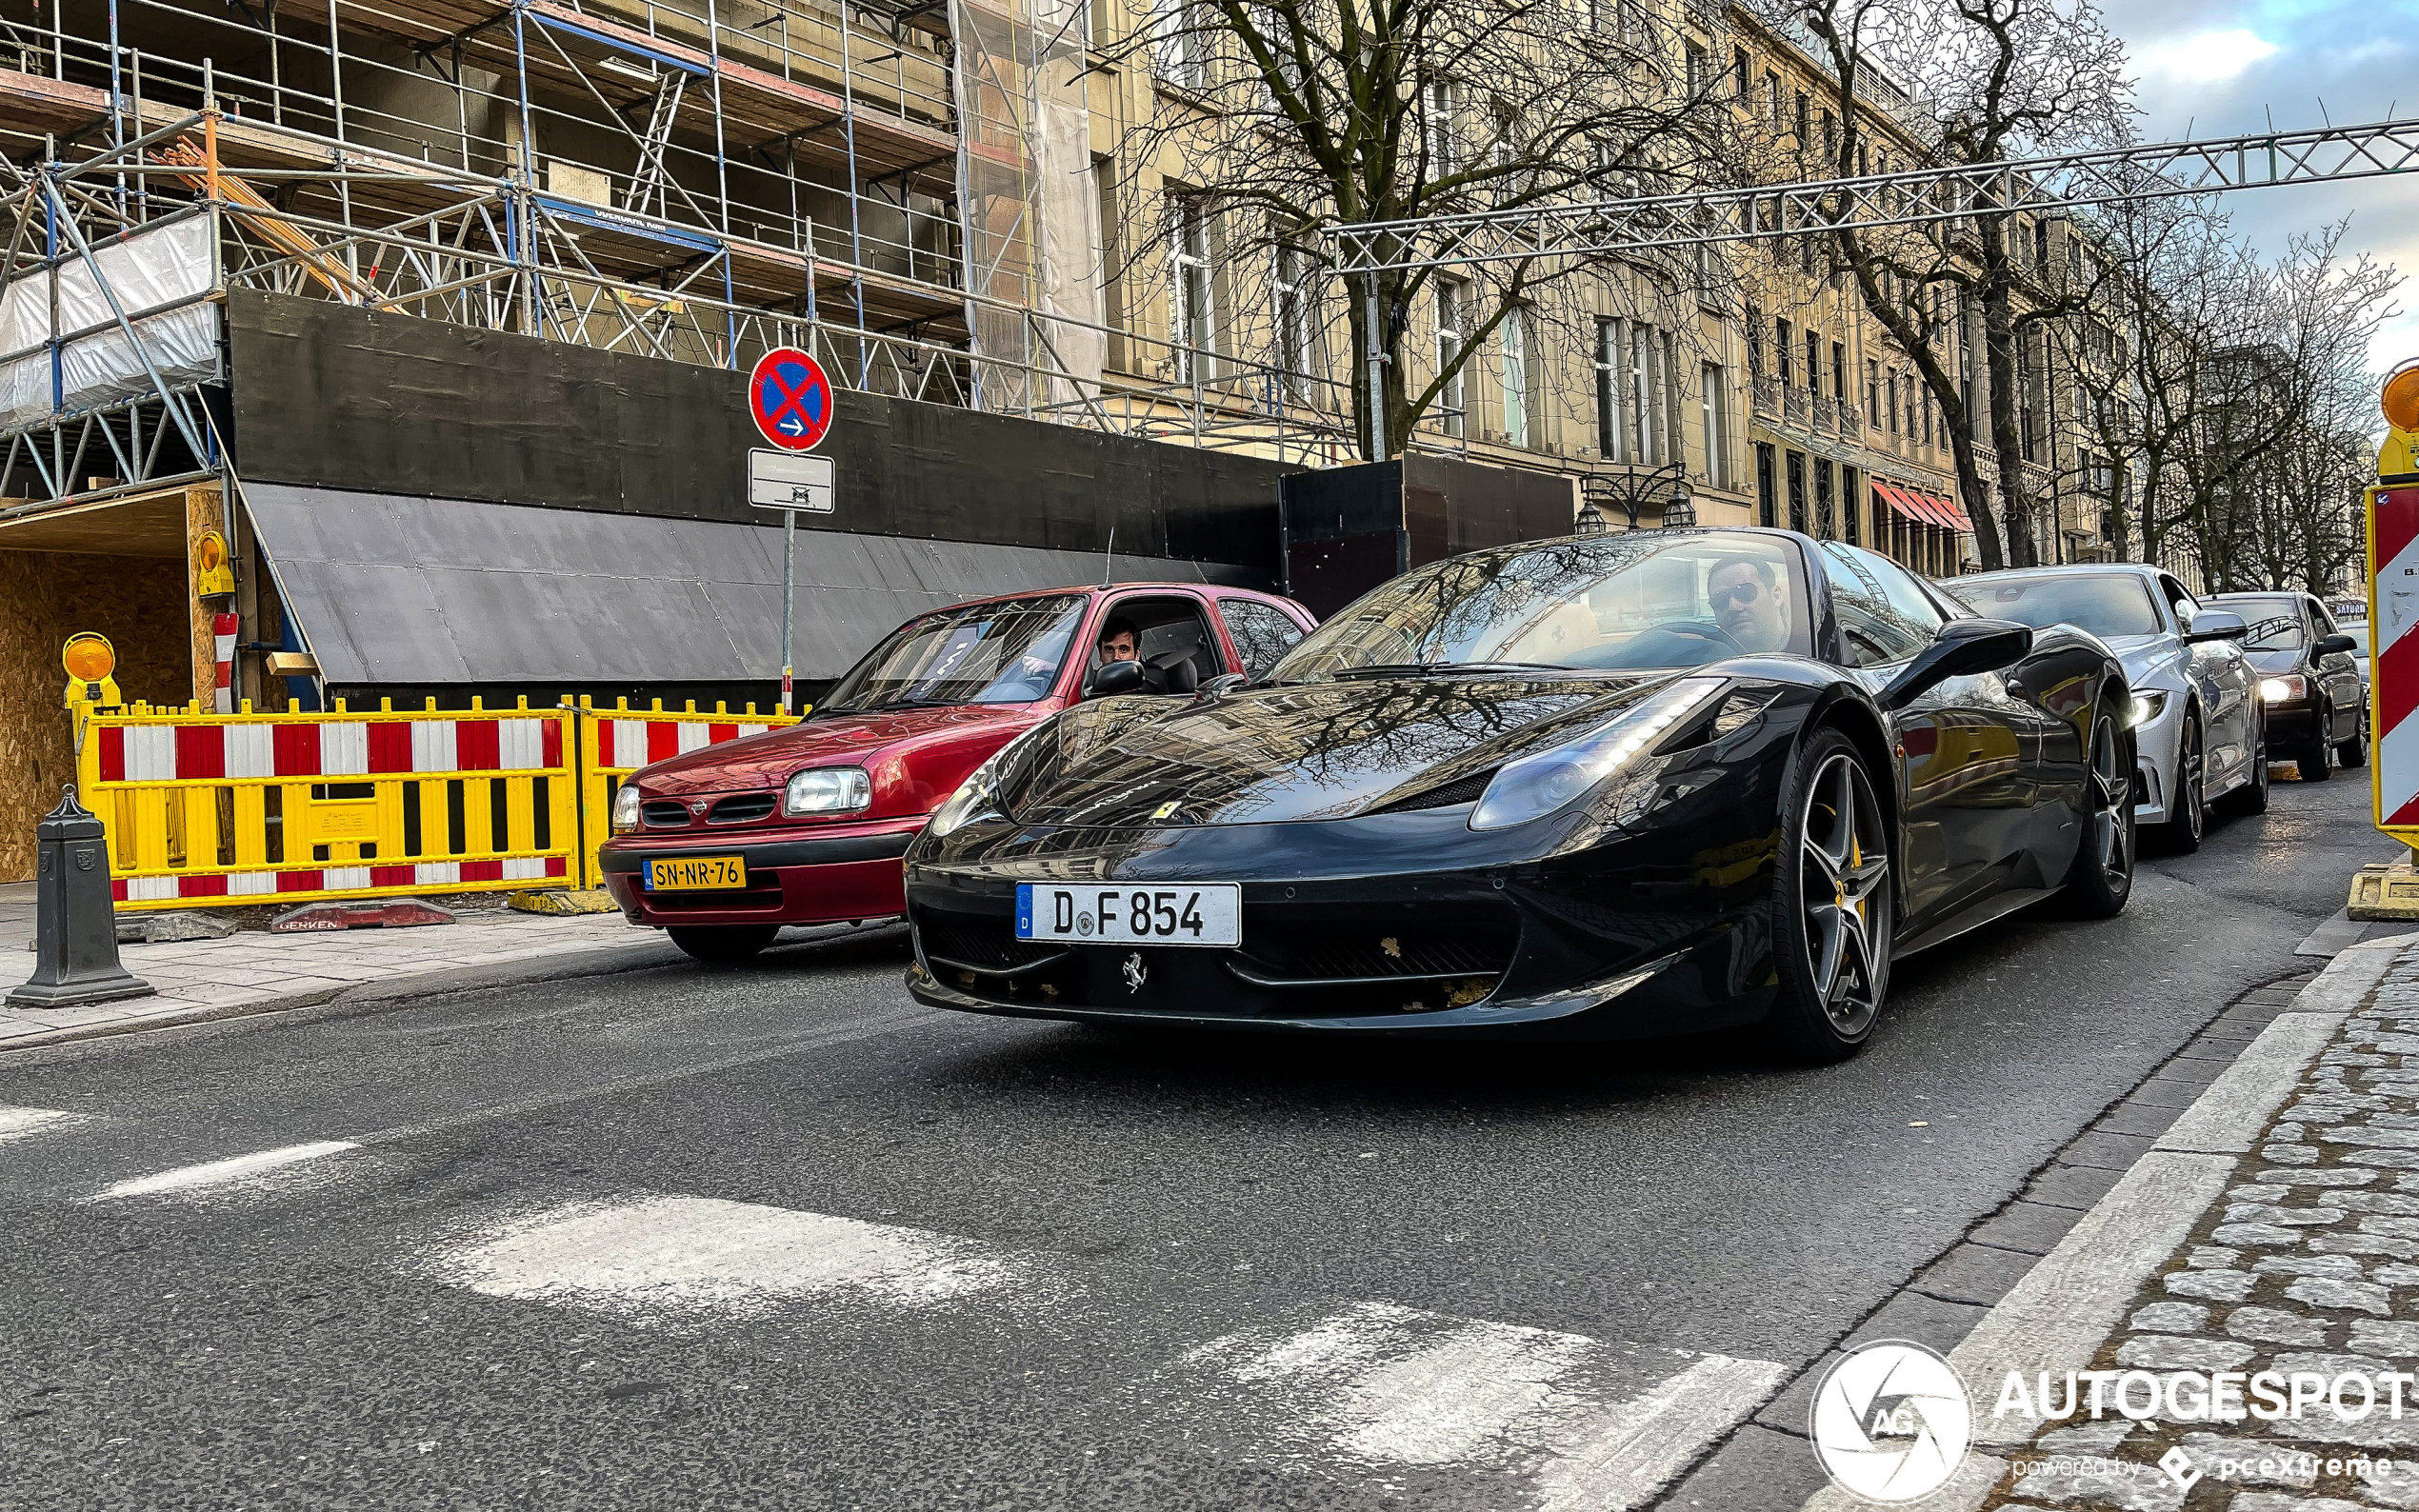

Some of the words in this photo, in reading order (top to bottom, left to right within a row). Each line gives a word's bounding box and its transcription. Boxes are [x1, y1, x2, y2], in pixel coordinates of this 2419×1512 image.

[2336, 605, 2366, 614] SATURN
[655, 861, 739, 886] SN-NR-76
[1054, 890, 1073, 933] D
[1098, 891, 1120, 935] F
[1130, 891, 1204, 937] 854
[279, 921, 337, 930] GERKEN
[1021, 917, 1029, 929] D
